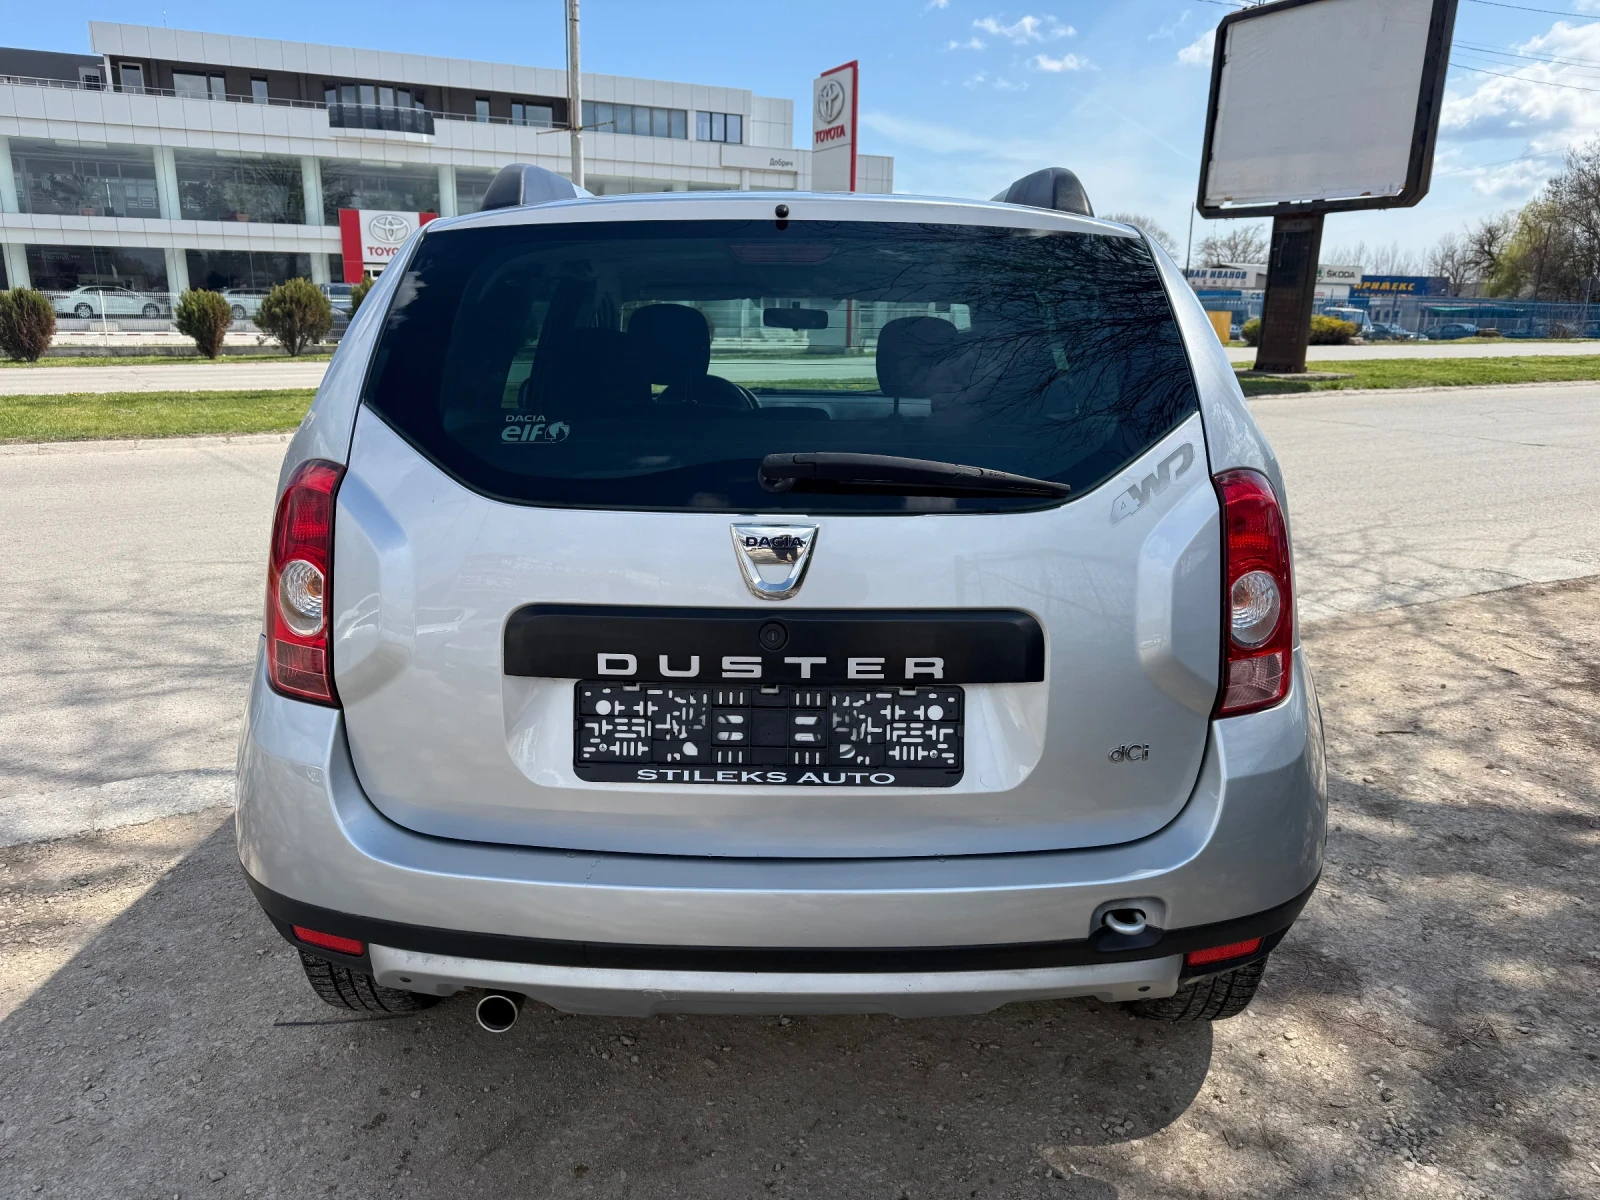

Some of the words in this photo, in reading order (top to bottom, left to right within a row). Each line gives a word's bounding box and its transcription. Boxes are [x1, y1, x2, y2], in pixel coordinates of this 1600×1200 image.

[815, 125, 845, 144] TOYOTA
[769, 158, 793, 168] Добрич
[367, 247, 399, 256] TOYO
[1182, 269, 1208, 279] ВАН
[1210, 270, 1248, 280] ИВАНОВ
[1326, 269, 1355, 279] ŠKODA
[505, 414, 546, 422] DACIA
[501, 423, 546, 442] elf
[1109, 441, 1195, 527] 4WD
[745, 536, 804, 547] DACIA
[597, 652, 945, 680] DUSTER
[1108, 742, 1150, 763] dCi
[636, 769, 788, 784] STILEKS
[794, 771, 896, 785] AUTO
